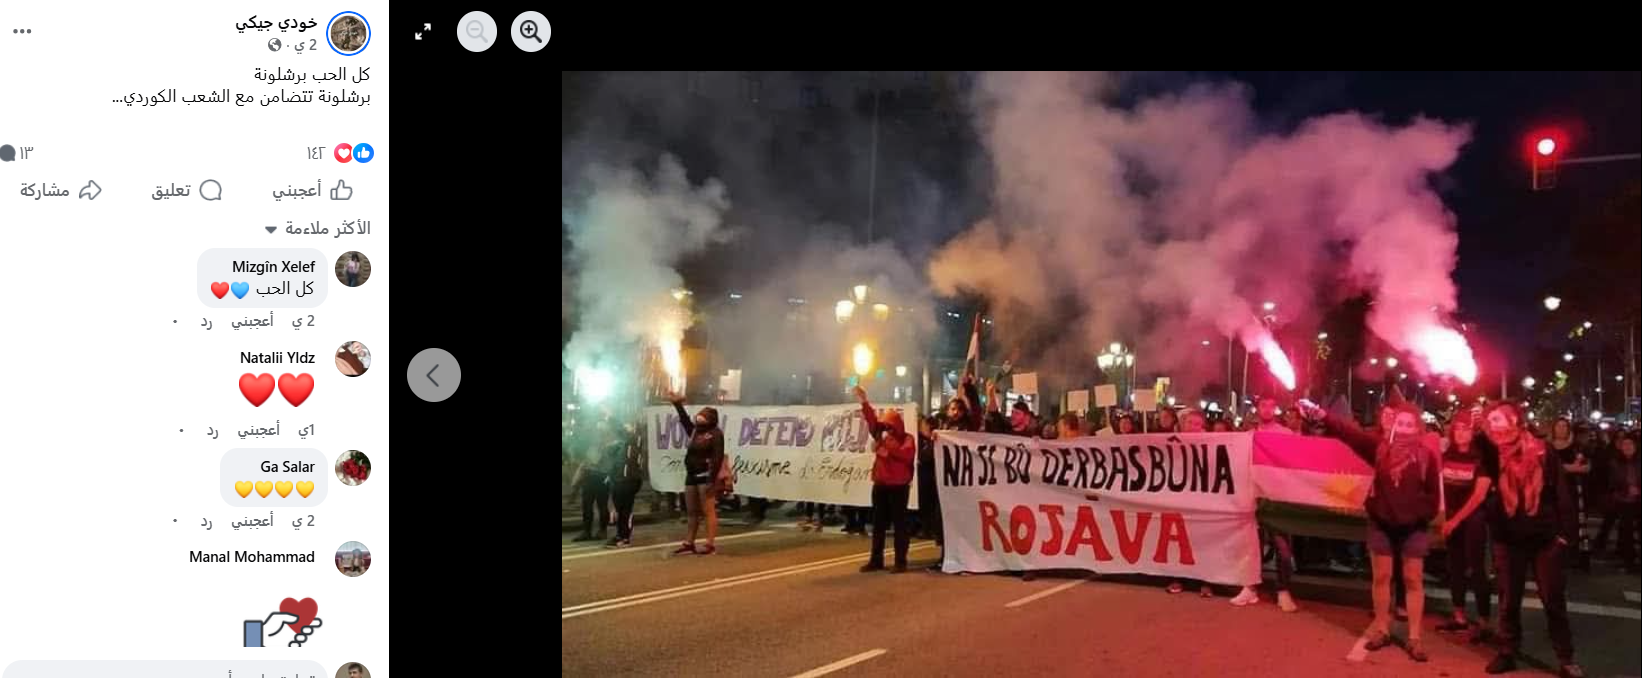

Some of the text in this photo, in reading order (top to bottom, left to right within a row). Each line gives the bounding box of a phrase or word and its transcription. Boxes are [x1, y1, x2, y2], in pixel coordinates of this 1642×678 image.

[236, 14, 318, 33] خودي جيكي
[295, 38, 318, 55] 2 ي
[255, 66, 371, 85] كل الحب برشلونة
[113, 88, 371, 107] برشلونة تتضامن مع الشعب الكوردي...
[20, 146, 34, 160] ١٣
[307, 146, 327, 160] ١٤٢
[20, 182, 70, 201] مشاركة
[152, 182, 192, 201] تعليق
[273, 179, 322, 202] أعجبني
[286, 219, 371, 239] الأكثر ملاءمة
[233, 260, 317, 276] Mizgîn Xelef
[256, 281, 315, 298] كل الحب
[201, 311, 315, 331] 2 ي أعجبني رد
[240, 351, 316, 364] Natalii Yldz
[207, 426, 219, 440] رد
[237, 420, 281, 440] أعجبني
[738, 416, 815, 448] DEFEND
[260, 460, 316, 473] Ga Salar
[201, 511, 315, 531] 2 ي أعجبني رد
[977, 500, 1196, 566] ROJAVA
[189, 550, 315, 563] Manal Mohammad
